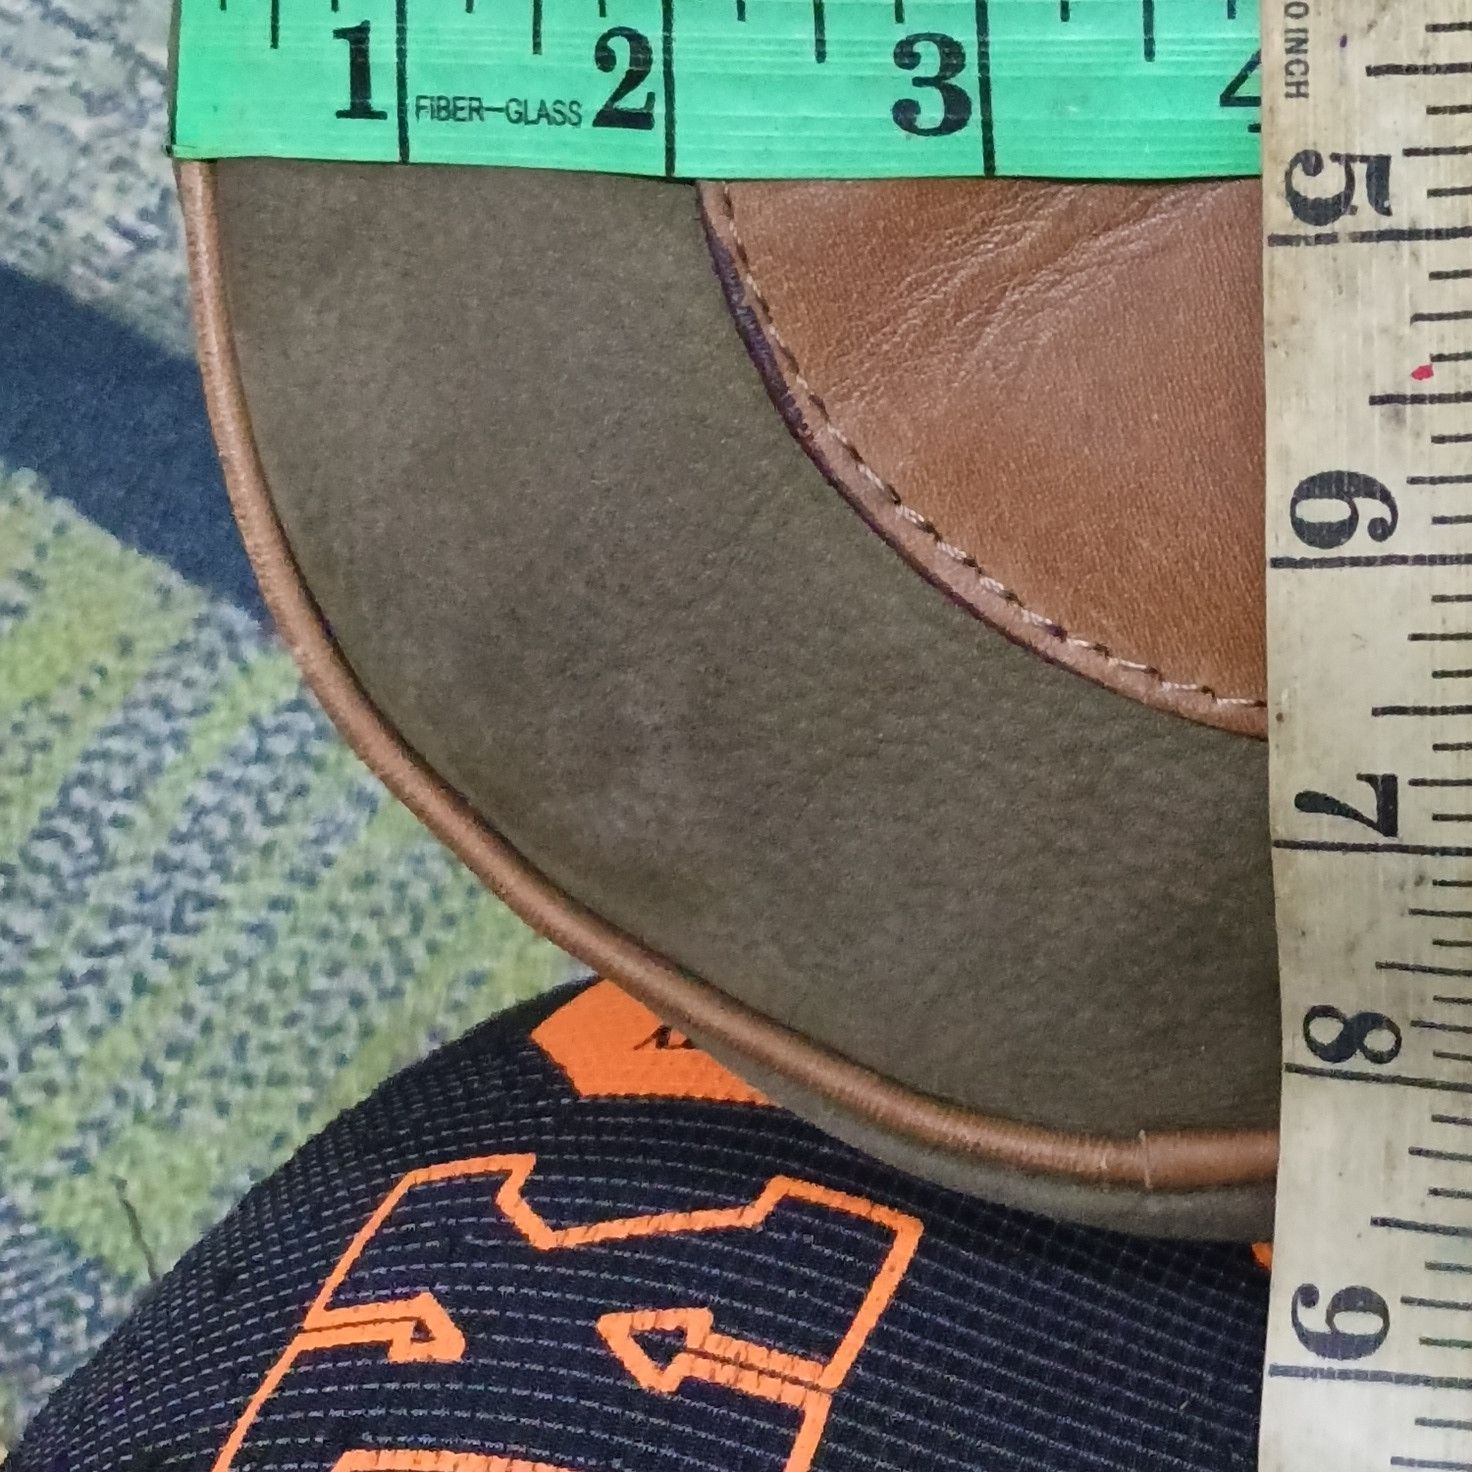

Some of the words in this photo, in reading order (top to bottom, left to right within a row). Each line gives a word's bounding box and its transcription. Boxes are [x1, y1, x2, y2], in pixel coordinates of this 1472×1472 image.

[333, 20, 387, 120] 1
[592, 26, 655, 130] 2
[891, 33, 972, 136] 3
[1284, 27, 1310, 99] INCH
[1285, 149, 1393, 226] 5
[1290, 470, 1398, 549] 6
[1294, 773, 1398, 838] 7
[1303, 1004, 1401, 1065] 8
[1291, 1283, 1390, 1360] 9
